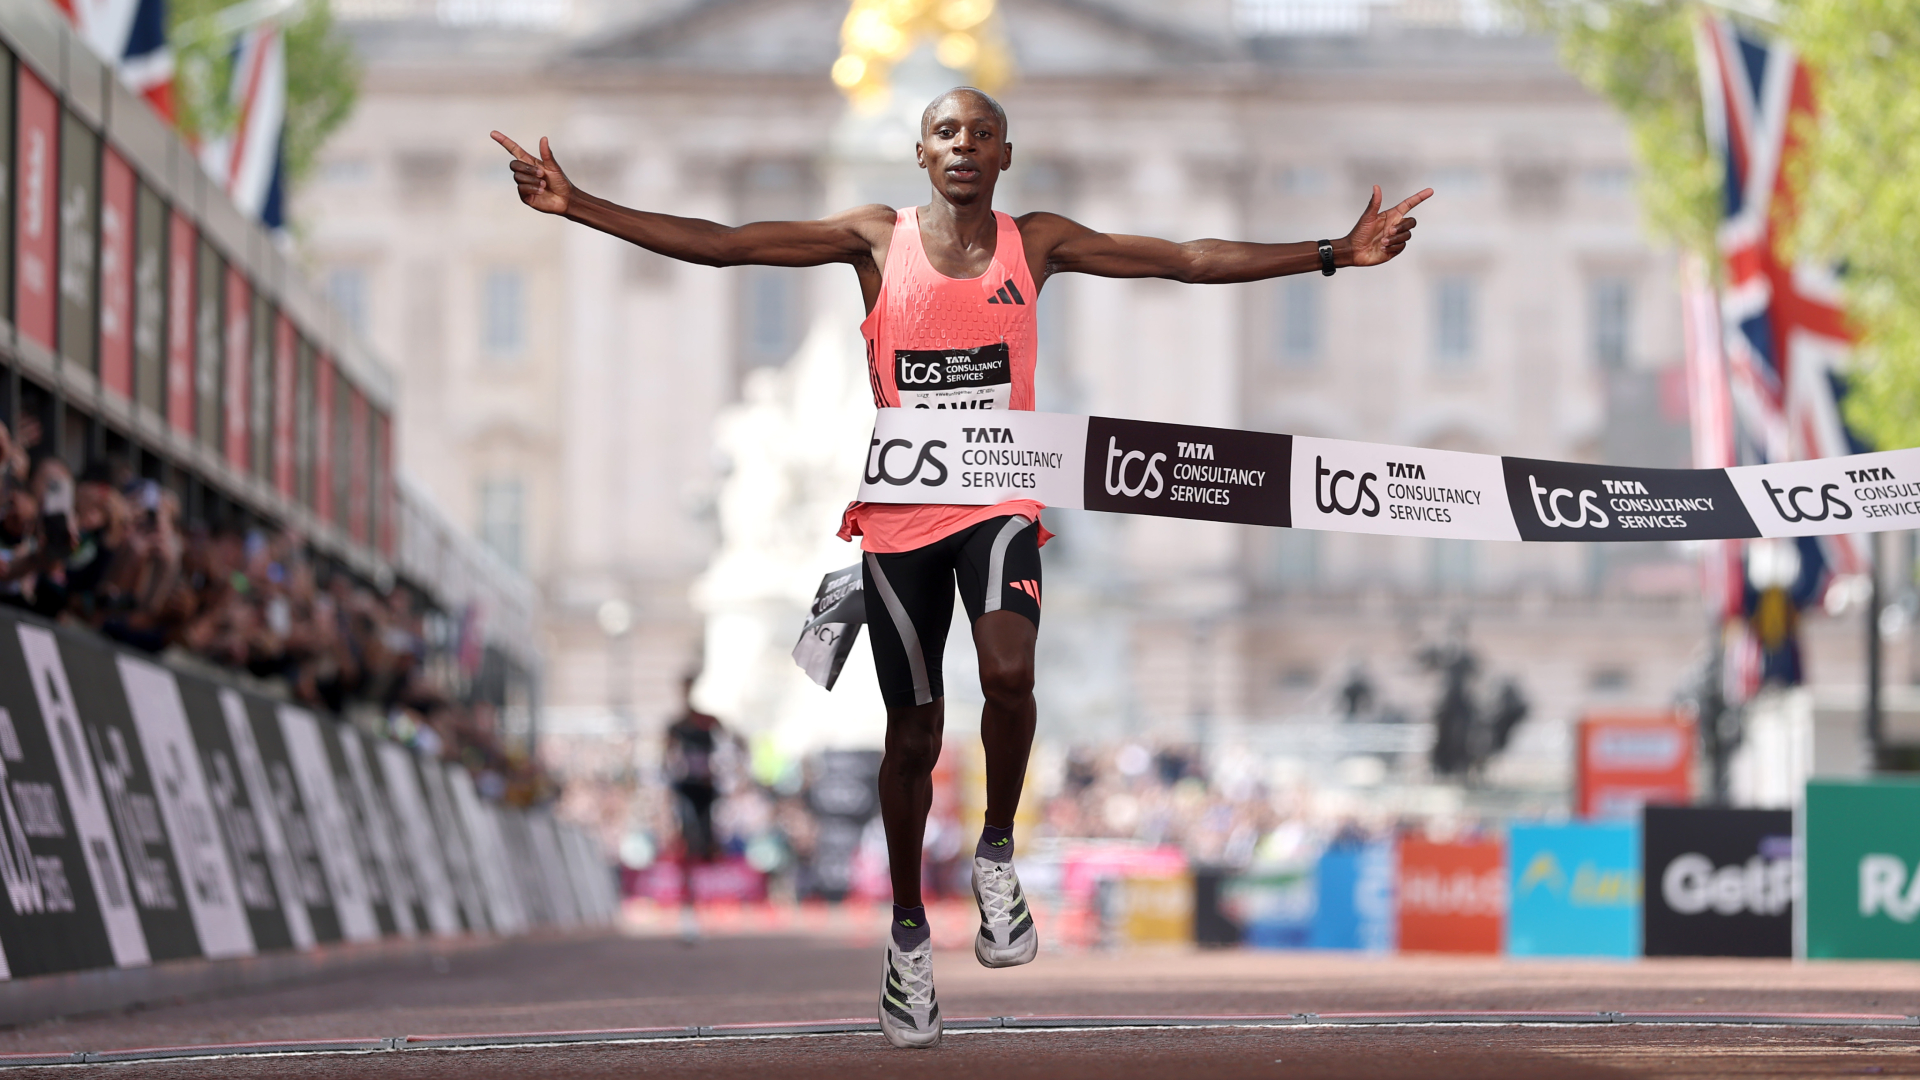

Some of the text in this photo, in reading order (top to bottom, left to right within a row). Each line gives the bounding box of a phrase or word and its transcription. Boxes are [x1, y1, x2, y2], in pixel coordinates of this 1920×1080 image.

[945, 356, 971, 364] TATA
[945, 360, 1002, 374] CONSULTANCY
[901, 357, 941, 384] tcs
[946, 372, 984, 383] SERVICES
[962, 427, 1014, 443] TATA
[864, 427, 948, 487] tcs
[961, 450, 1063, 469] CONSULTANCY
[1177, 441, 1215, 461] TATA
[1105, 435, 1167, 499] tcs
[1173, 463, 1266, 487] CONSULTANCY
[1386, 461, 1426, 480] TATA
[1845, 467, 1896, 483] TATA
[961, 472, 1036, 489] SERVICES
[1315, 455, 1380, 518] tcs
[1601, 479, 1649, 495] TATA
[1170, 484, 1230, 506] SERVICES
[1387, 483, 1481, 505] CONSULTANCY
[1528, 474, 1610, 528] tcs
[1761, 479, 1853, 522] tcs
[1389, 504, 1452, 523] SERVICES
[1610, 497, 1715, 512] CONSULTANCY
[1617, 515, 1687, 528] SERVICES
